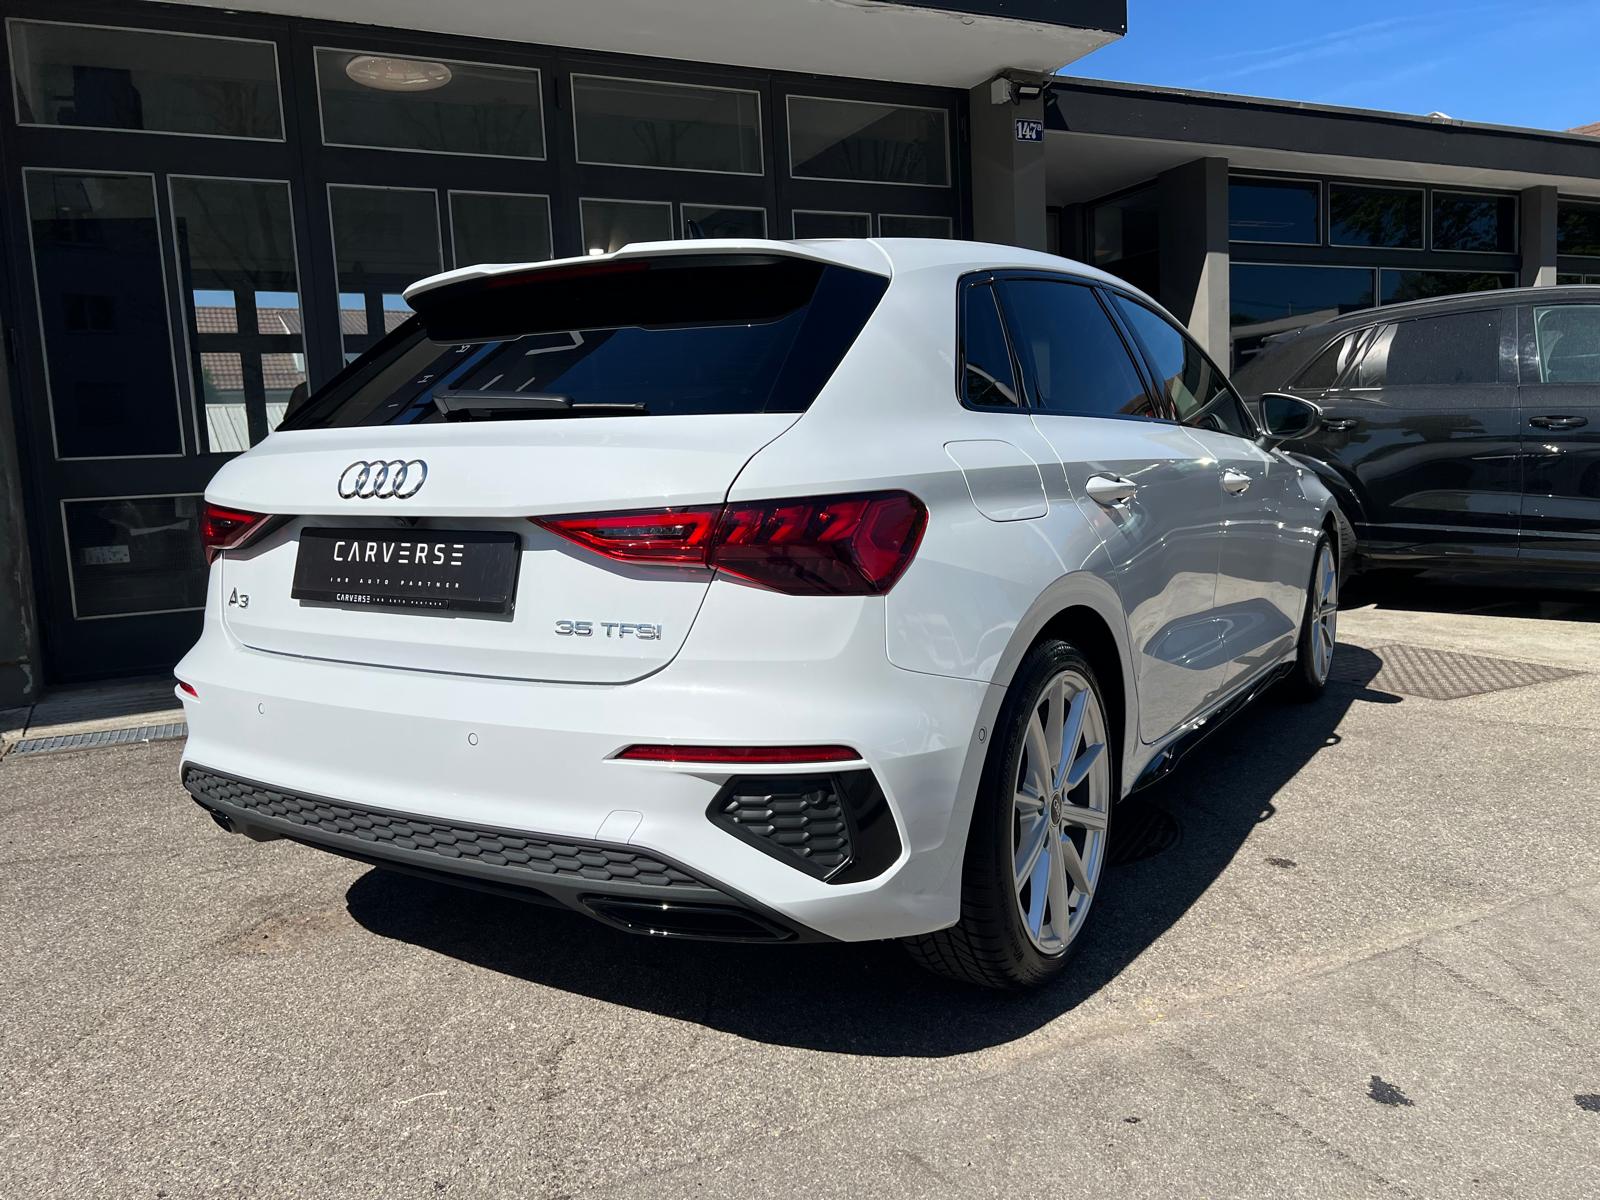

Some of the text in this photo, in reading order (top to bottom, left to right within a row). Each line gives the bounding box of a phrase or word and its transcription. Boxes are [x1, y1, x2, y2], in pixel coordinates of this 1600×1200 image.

[333, 541, 465, 566] CARVERSE
[400, 580, 460, 589] PARTNER
[228, 587, 250, 609] A3
[336, 593, 371, 604] CARVERSE
[554, 620, 662, 641] 35 TFSI
